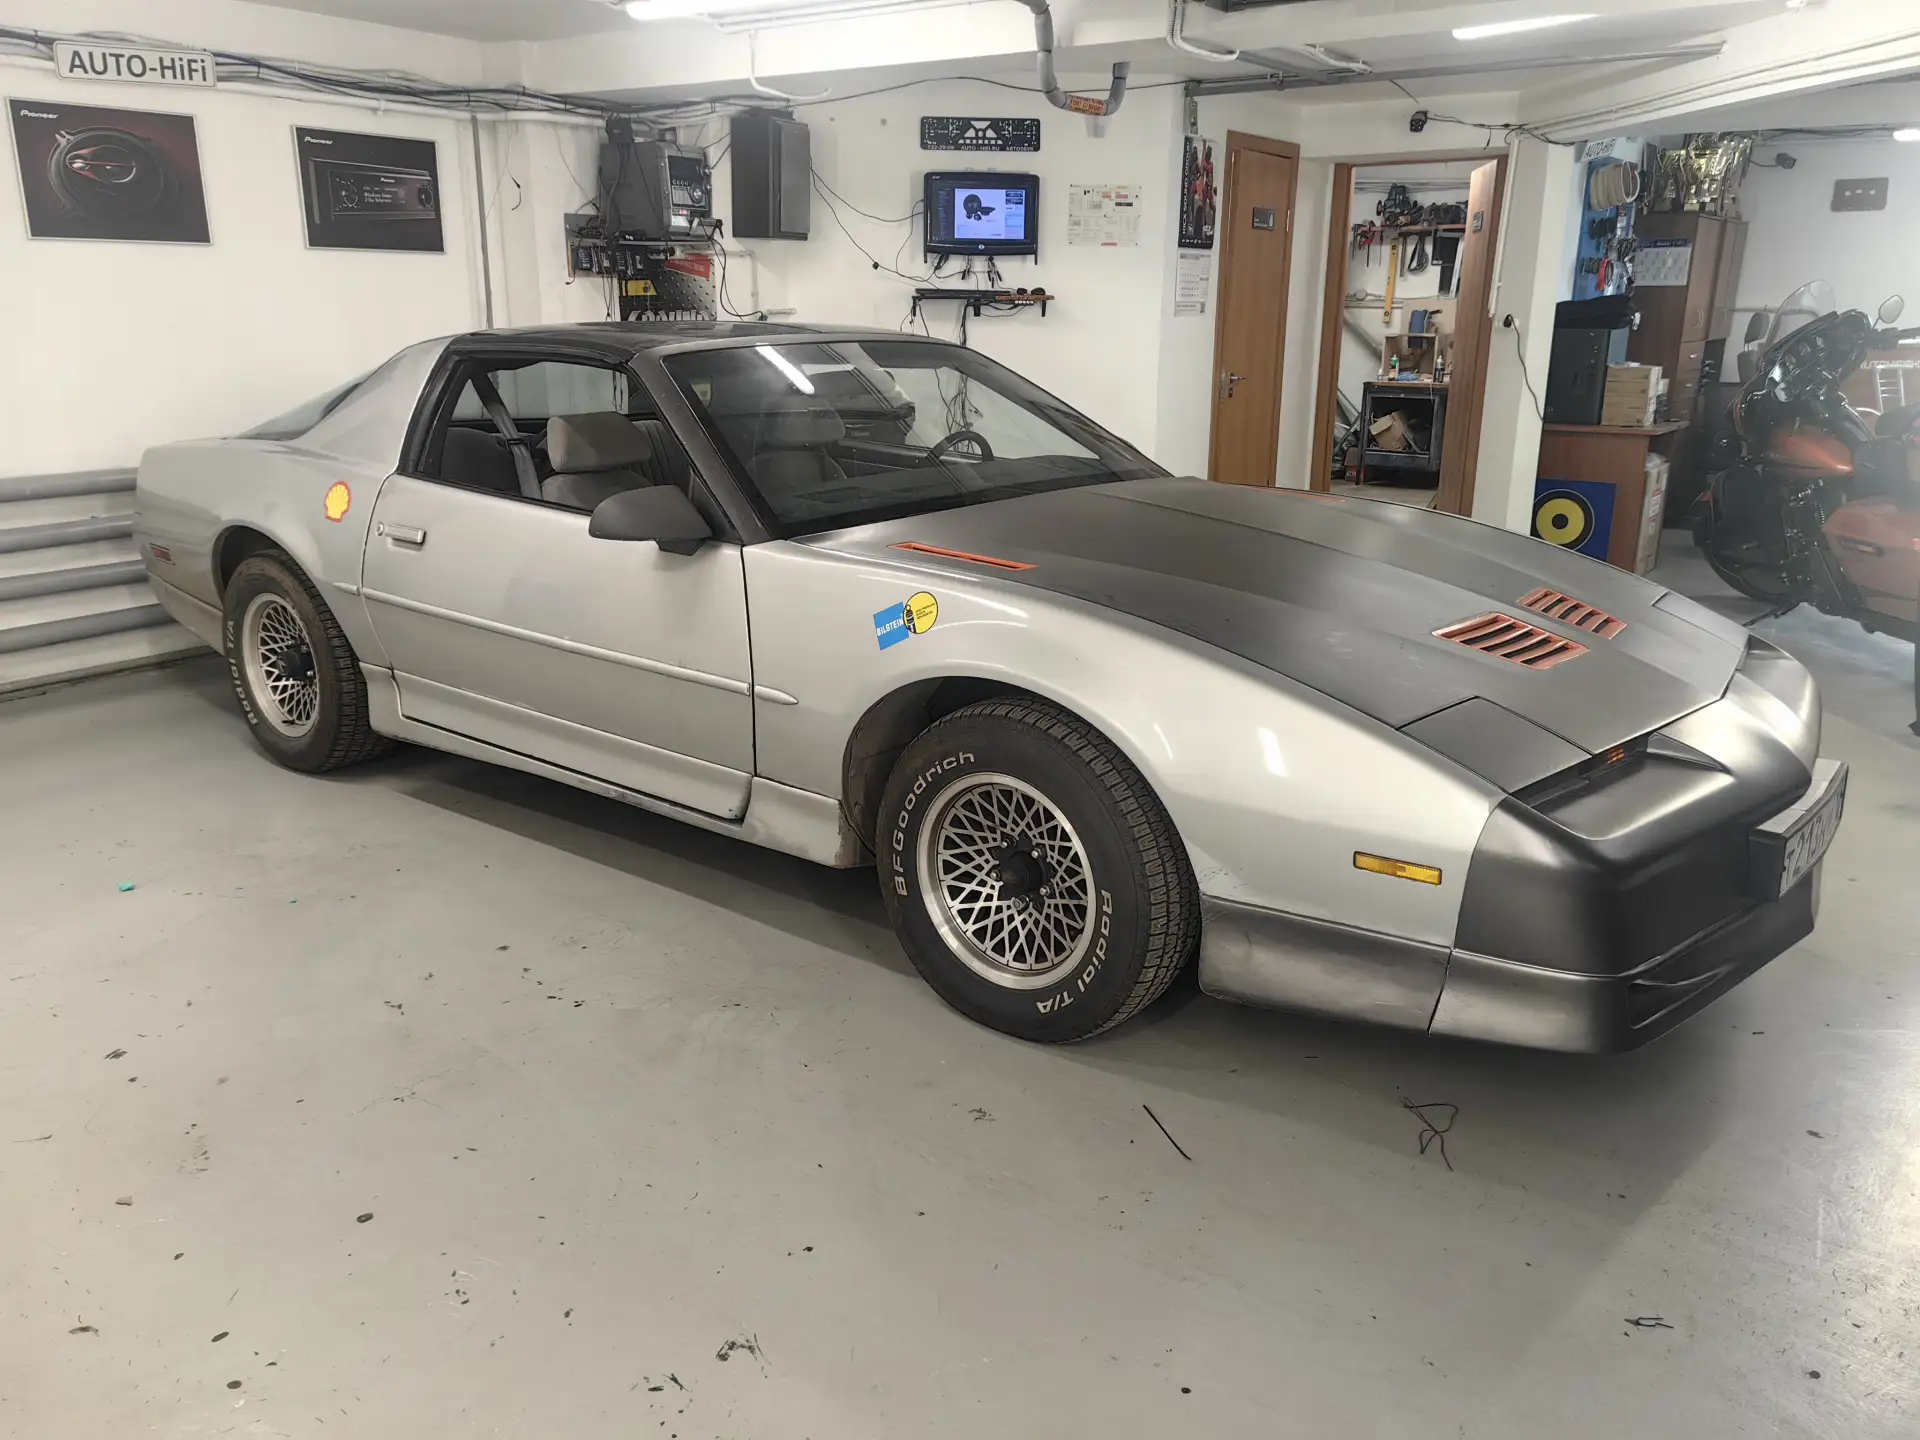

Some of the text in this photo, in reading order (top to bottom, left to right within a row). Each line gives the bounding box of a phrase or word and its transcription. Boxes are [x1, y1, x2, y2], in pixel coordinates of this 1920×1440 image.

[68, 50, 207, 82] AUTO-HiFi
[20, 109, 59, 118] Pioneer
[304, 136, 333, 145] Pioneer
[876, 617, 904, 637] BILSTEIN
[226, 621, 259, 725] Radial T/A
[891, 751, 976, 897] BFGoodrich
[1036, 889, 1113, 1014] Radial T/A
